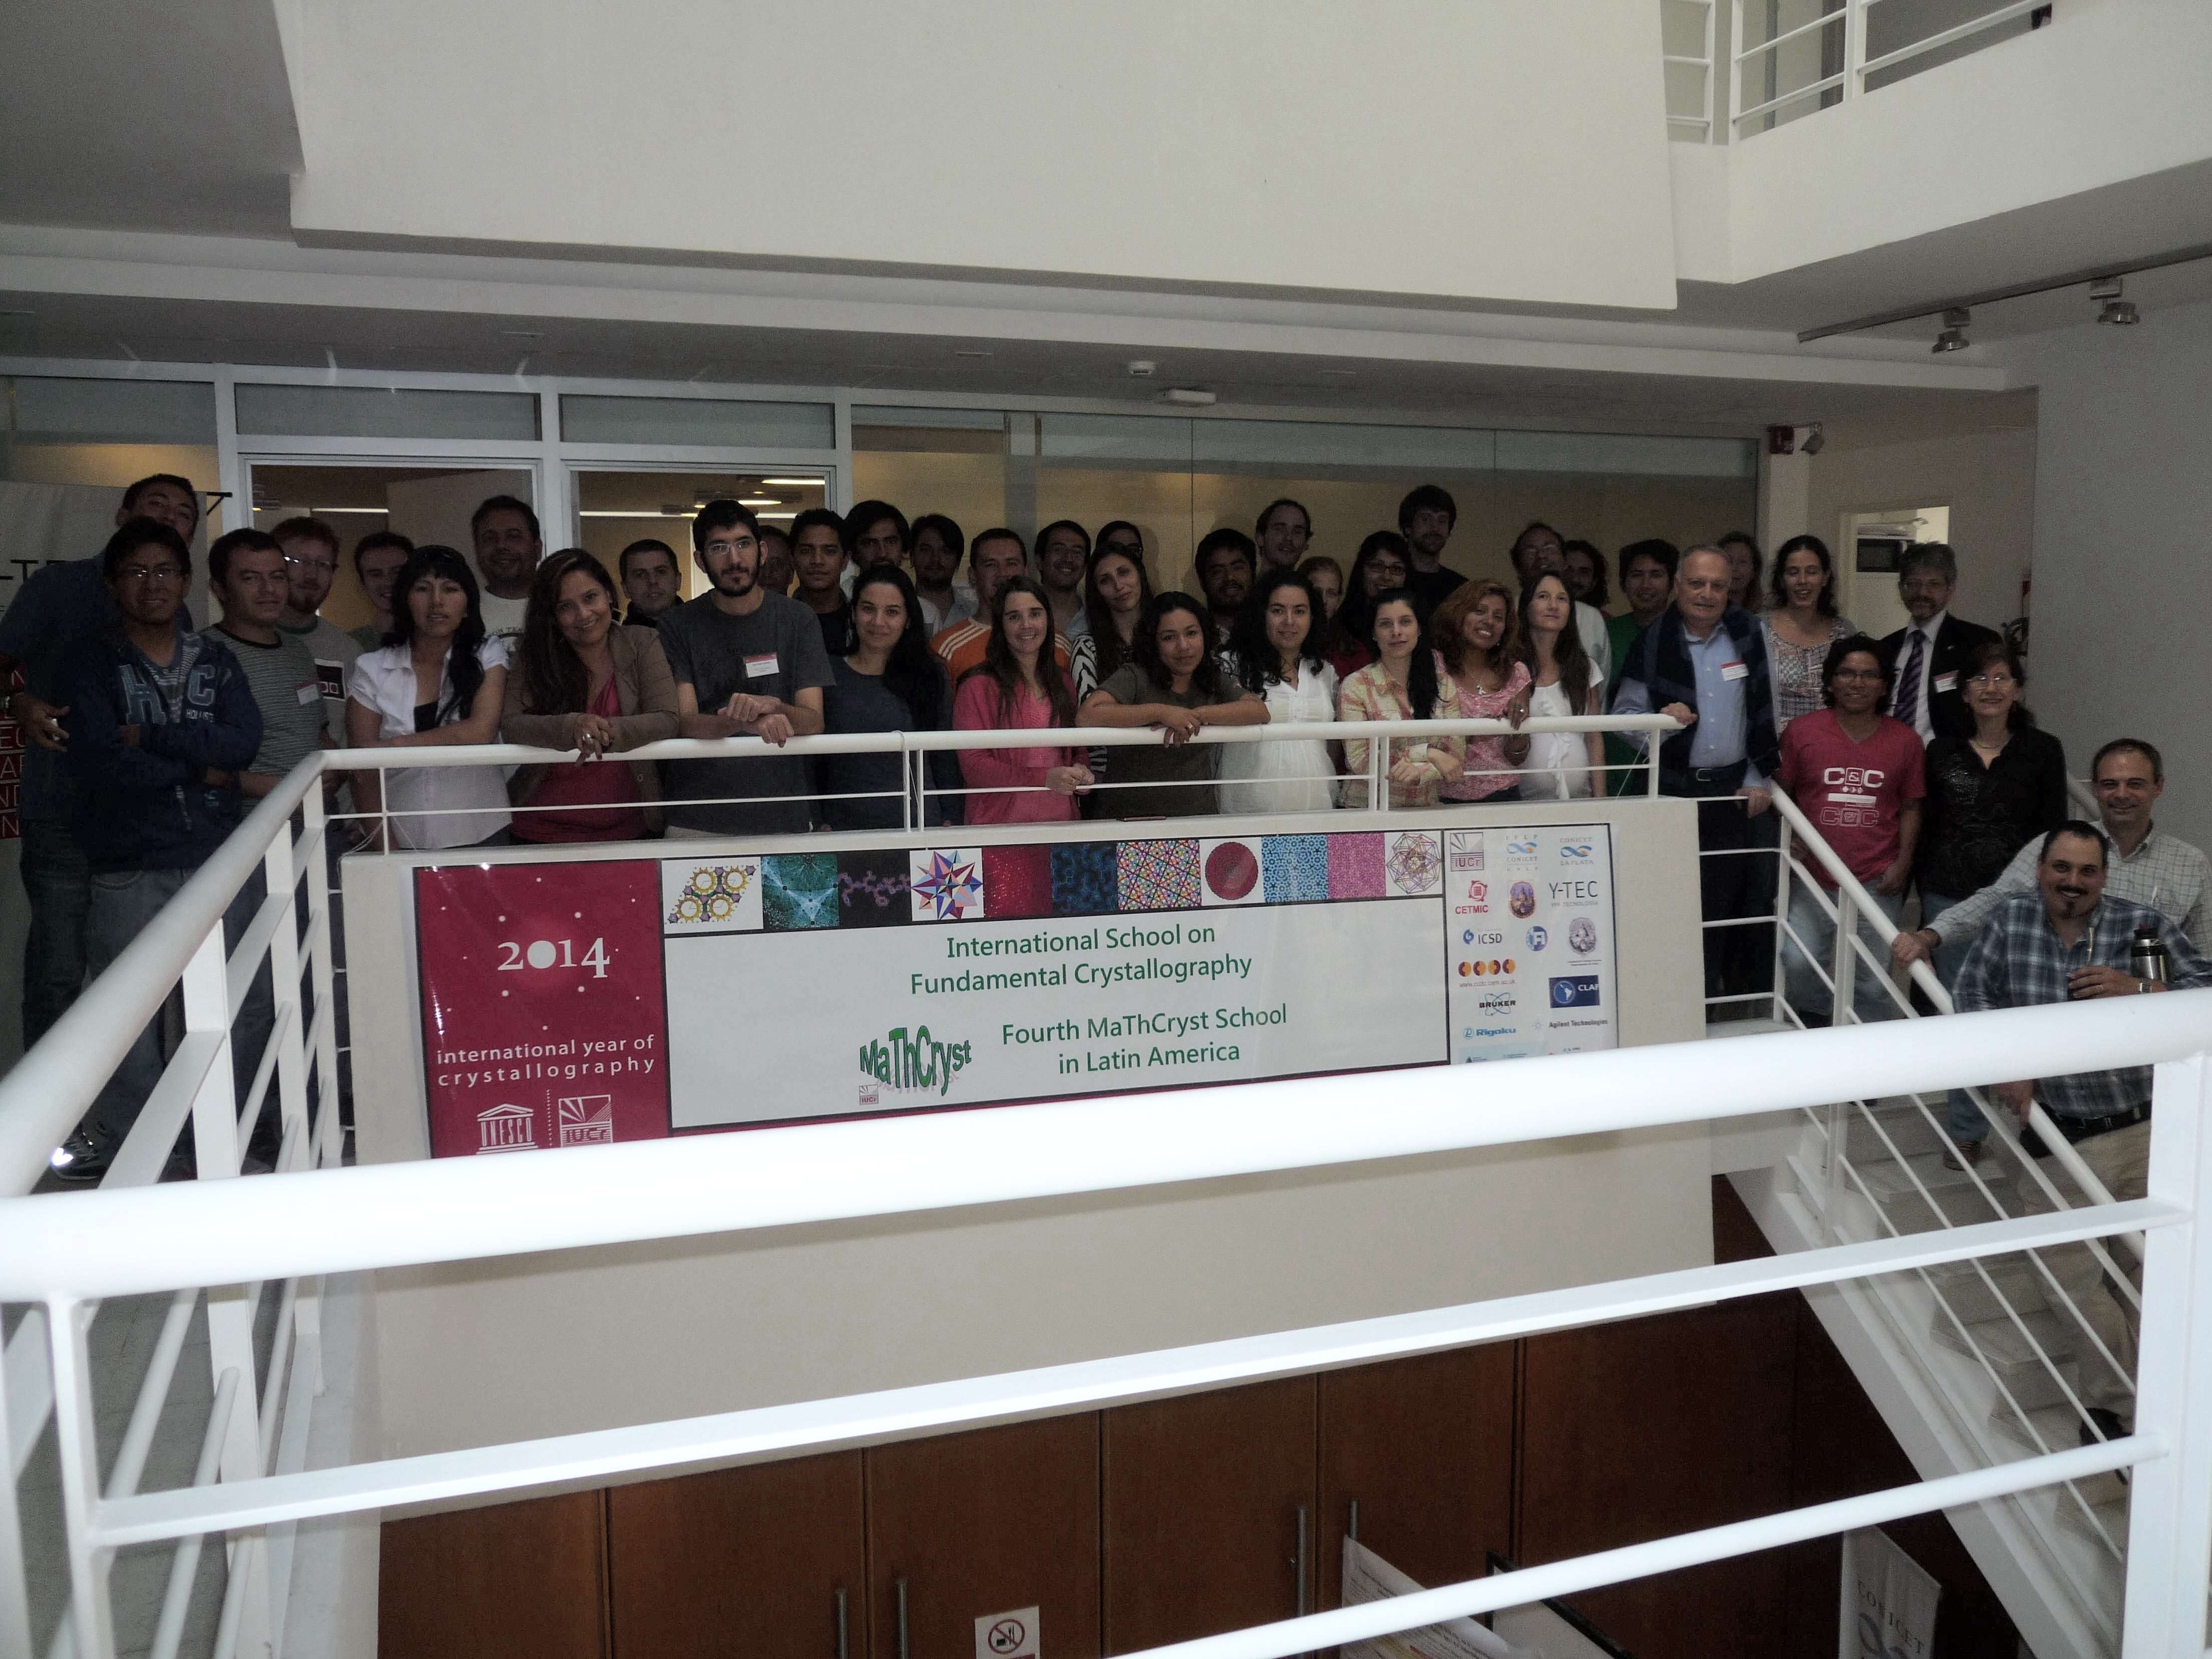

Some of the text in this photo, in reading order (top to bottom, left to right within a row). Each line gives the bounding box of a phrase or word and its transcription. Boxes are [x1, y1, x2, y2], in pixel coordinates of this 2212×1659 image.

[1549, 881, 1598, 899] Y-TEC
[1455, 905, 1489, 915] CETMIC
[947, 923, 1215, 958] International School on
[1478, 933, 1502, 944] ICSD
[497, 937, 611, 979] 2014
[911, 953, 1252, 995] Fundamental Crystallography
[1479, 999, 1516, 1008] BRUKER
[1002, 1002, 1286, 1045] Fourth MaThCryst School
[1476, 1027, 1516, 1037] Rigaku
[1571, 1018, 1608, 1026] Technologies
[437, 1034, 655, 1065] international year of
[860, 1025, 972, 1096] MaThCryst
[1059, 1041, 1240, 1074] in Latin America
[438, 1056, 655, 1088] crystallography
[480, 1117, 533, 1147] UNESCO
